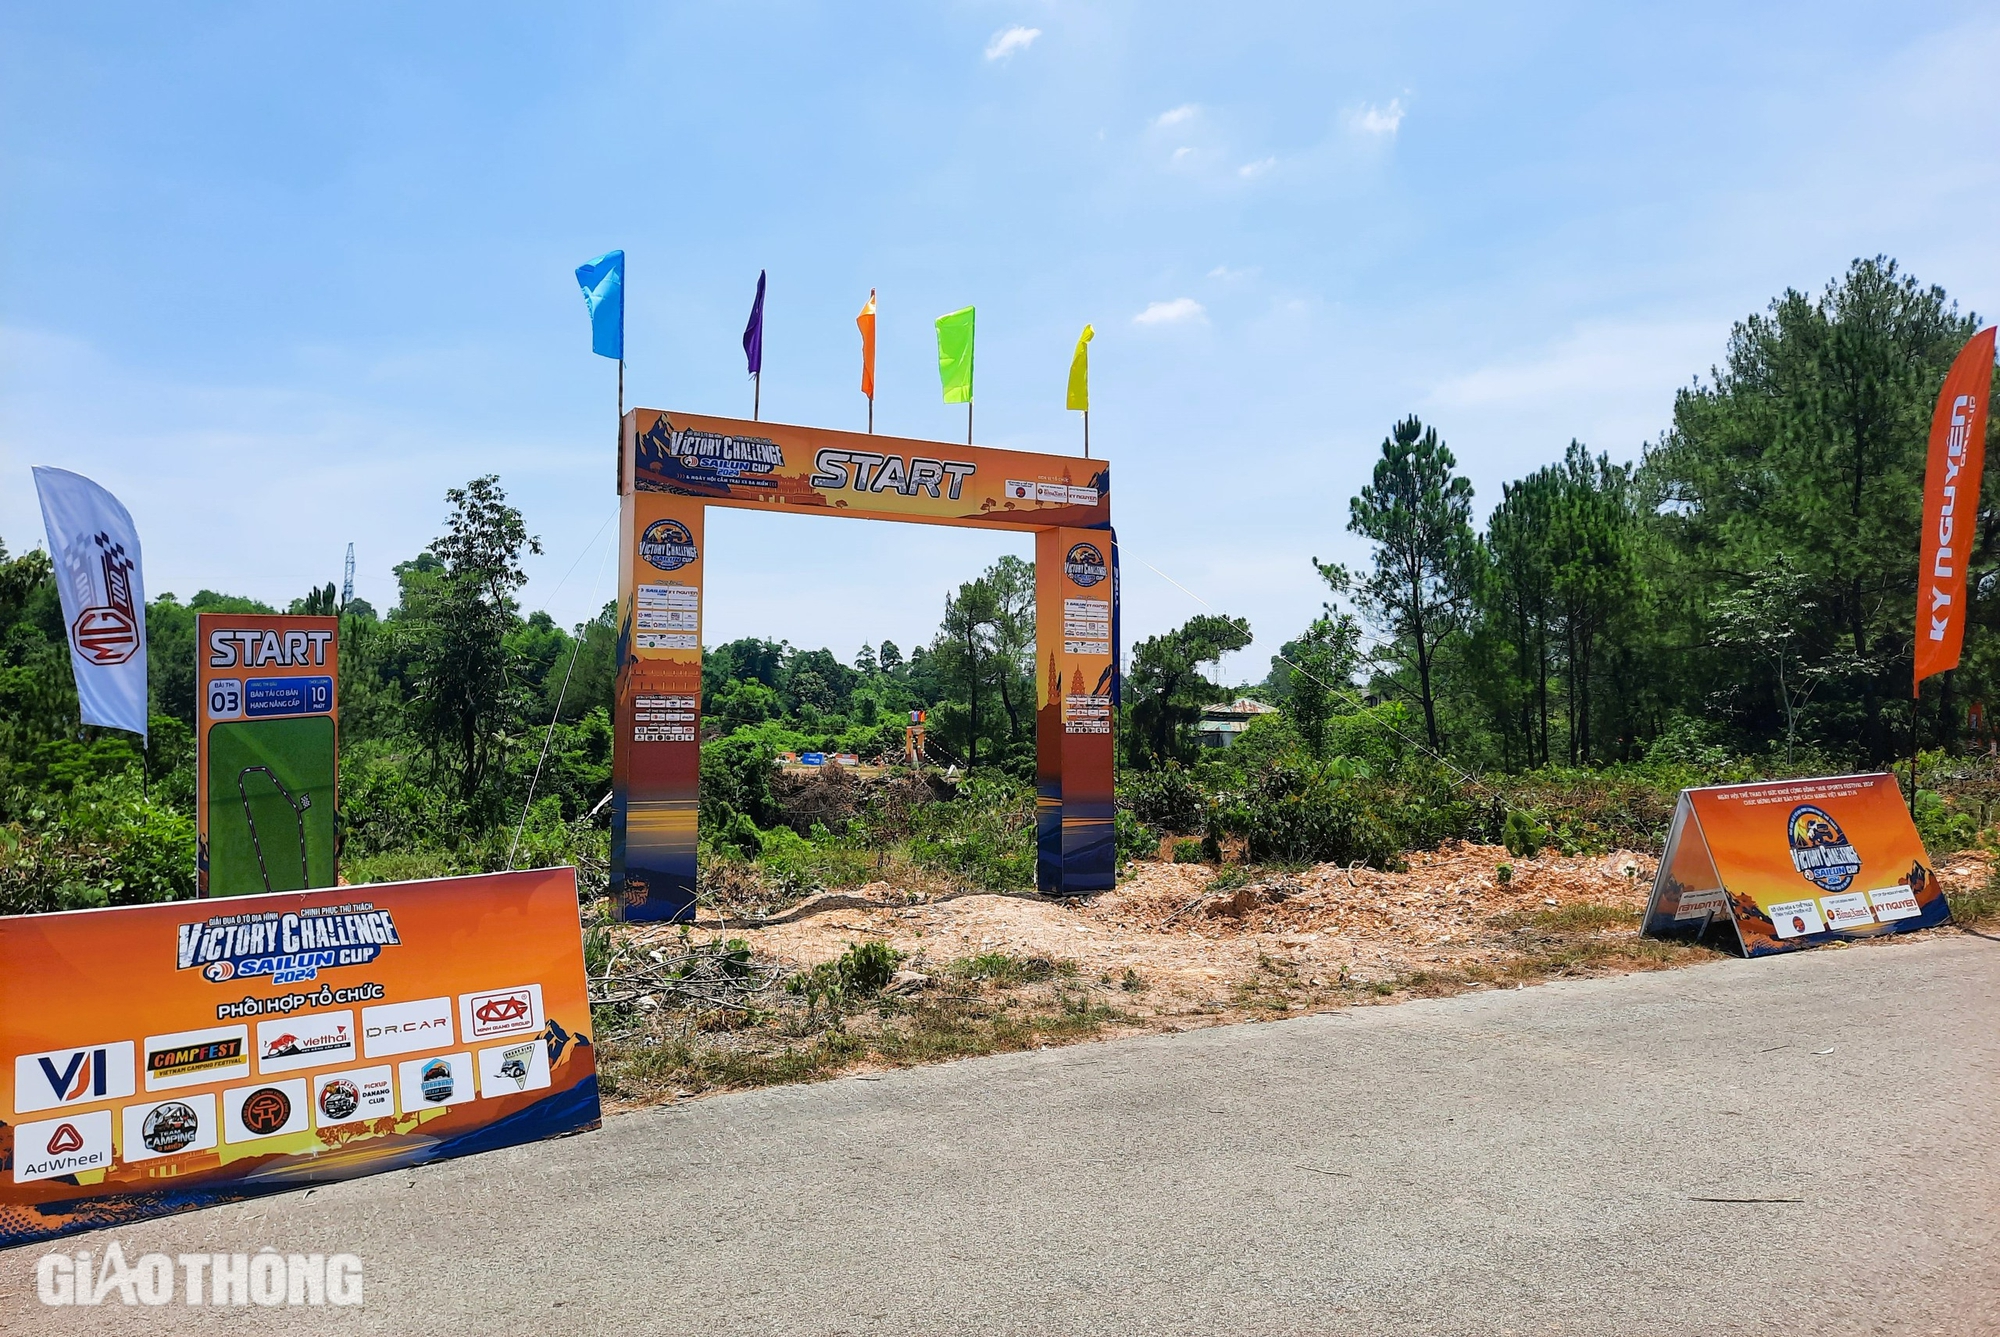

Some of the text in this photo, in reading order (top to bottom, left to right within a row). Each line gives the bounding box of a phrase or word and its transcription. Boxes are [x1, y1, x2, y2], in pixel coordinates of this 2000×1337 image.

[724, 436, 784, 466] CHALLENGE
[700, 458, 771, 473] SAILUN CUP
[717, 468, 741, 477] 2024
[811, 448, 977, 500] START
[79, 612, 134, 660] MG
[210, 629, 333, 668] START
[211, 691, 239, 712] 03
[311, 686, 326, 702] 10
[1814, 864, 1859, 878] SAILUN CUP
[223, 916, 236, 925] ĐUA
[236, 914, 241, 923] Ô
[242, 914, 250, 923] TÔ
[262, 912, 279, 921] HÌNH
[301, 907, 320, 917] CHINH
[321, 906, 339, 915] PHỤC
[353, 902, 373, 911] THÁCH
[282, 911, 399, 954] CHALLENGE
[238, 946, 375, 976] SAILUN CUP
[272, 968, 317, 984] 2024
[218, 983, 384, 1019] PHỐI HỢP TỔ CHỨC
[366, 1018, 446, 1038] DR.CAR
[511, 1020, 530, 1028] GROUP
[154, 1042, 237, 1068] CAMPFEST
[159, 1057, 242, 1077] VIETNAM CAMPING FESTIVAL
[362, 1089, 390, 1098] DANANG
[368, 1097, 385, 1105] CLUB
[145, 1130, 195, 1149] CAMPING
[24, 1151, 103, 1176] AdWheel
